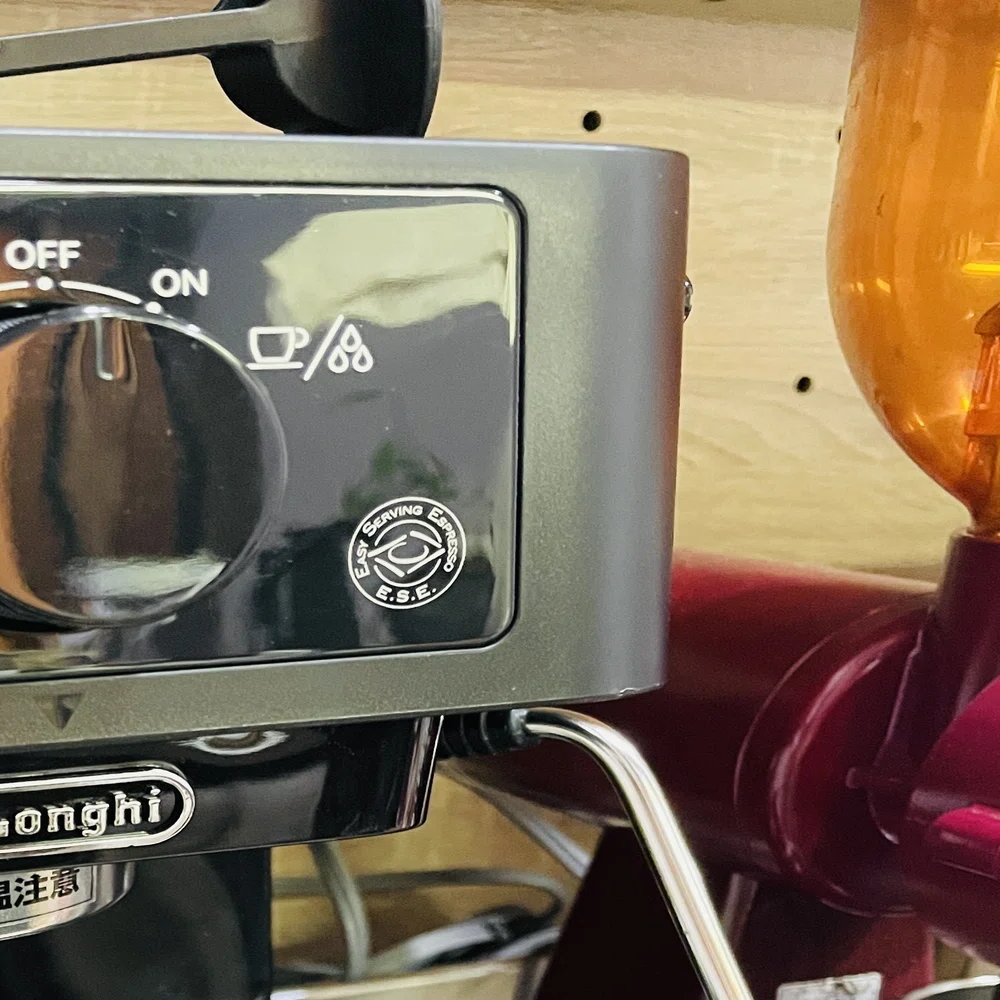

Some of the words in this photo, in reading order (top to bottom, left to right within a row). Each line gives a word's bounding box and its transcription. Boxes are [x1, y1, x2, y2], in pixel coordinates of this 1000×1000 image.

[5, 239, 81, 270] OFF
[151, 268, 208, 298] ON
[362, 505, 424, 538] SERVING
[427, 507, 458, 573] ESPRESSO
[375, 583, 437, 604] E.S.E.
